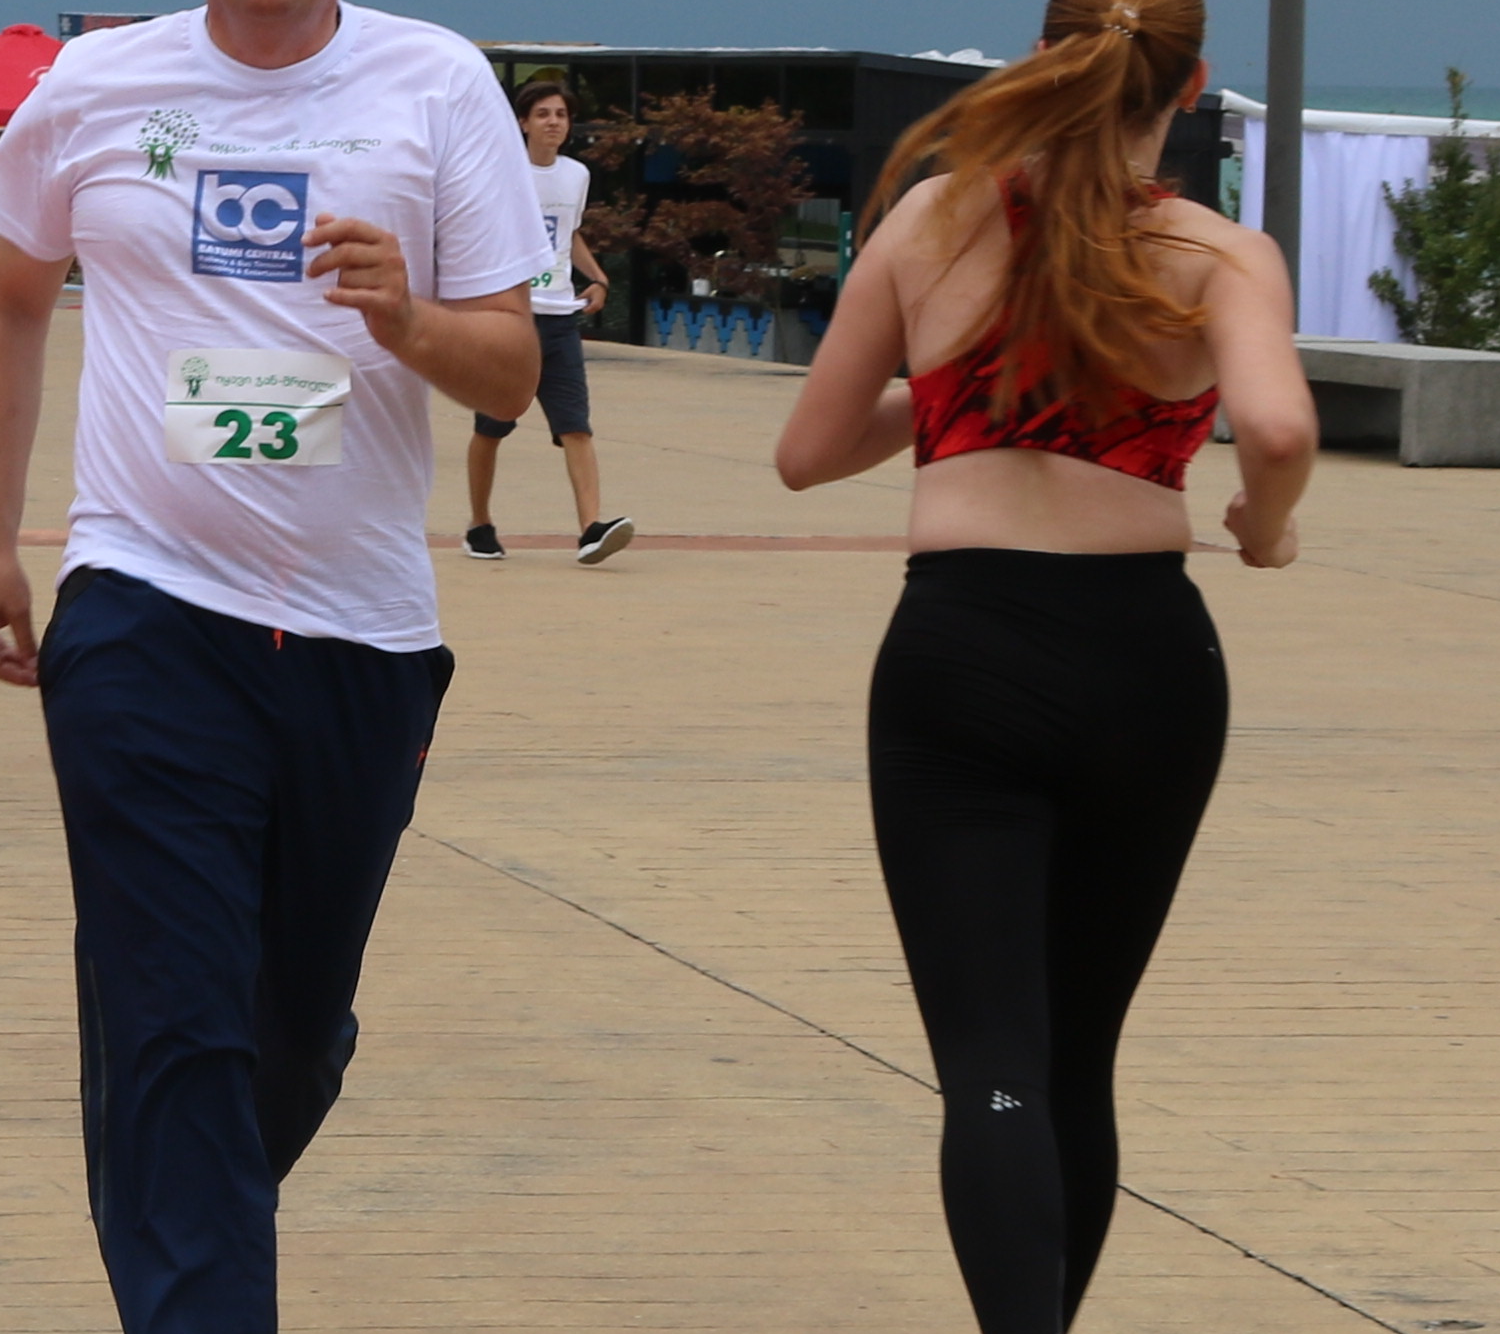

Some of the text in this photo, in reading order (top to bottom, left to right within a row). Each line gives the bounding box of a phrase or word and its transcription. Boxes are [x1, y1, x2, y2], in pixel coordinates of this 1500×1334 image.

[197, 243, 297, 261] BATUMI CENTRAL
[212, 408, 299, 461] 23
